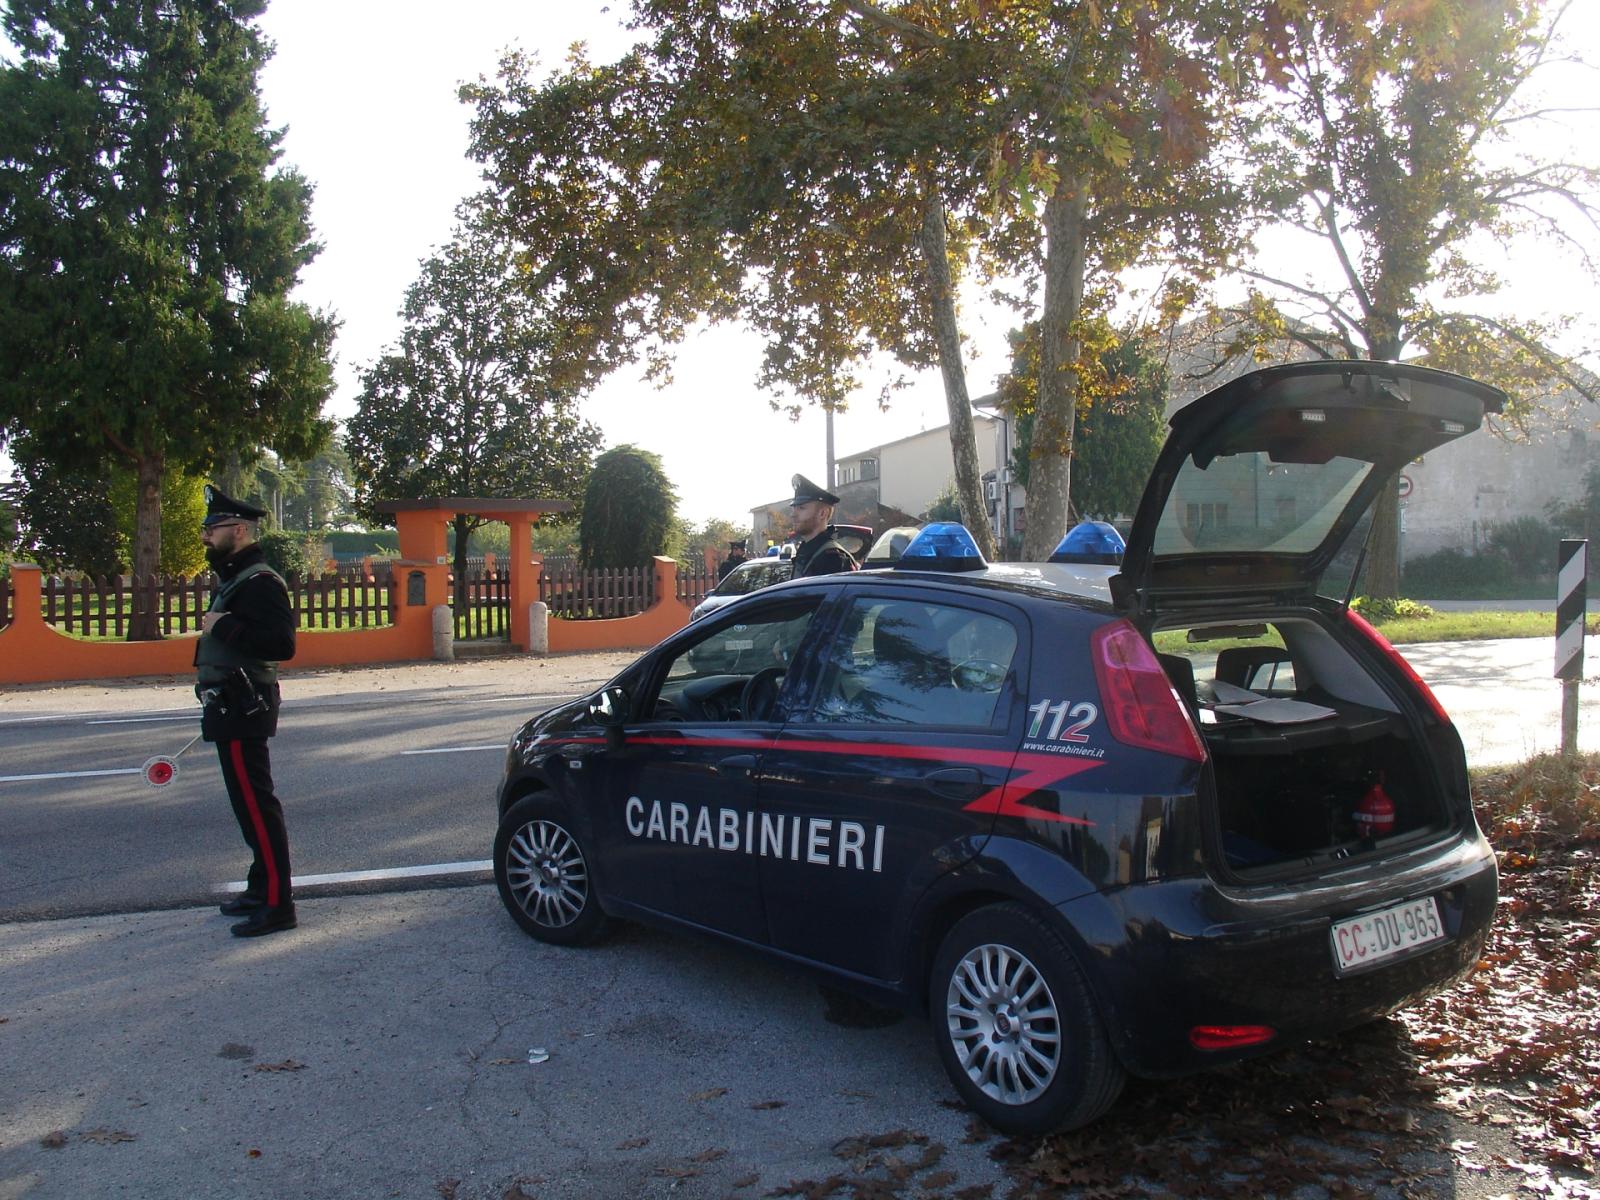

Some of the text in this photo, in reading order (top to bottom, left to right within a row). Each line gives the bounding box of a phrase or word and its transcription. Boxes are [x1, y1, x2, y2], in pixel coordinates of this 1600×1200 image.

[1027, 698, 1098, 743] 112
[1023, 742, 1105, 757] www.carabinieri.it
[625, 796, 885, 873] CARABINIERI
